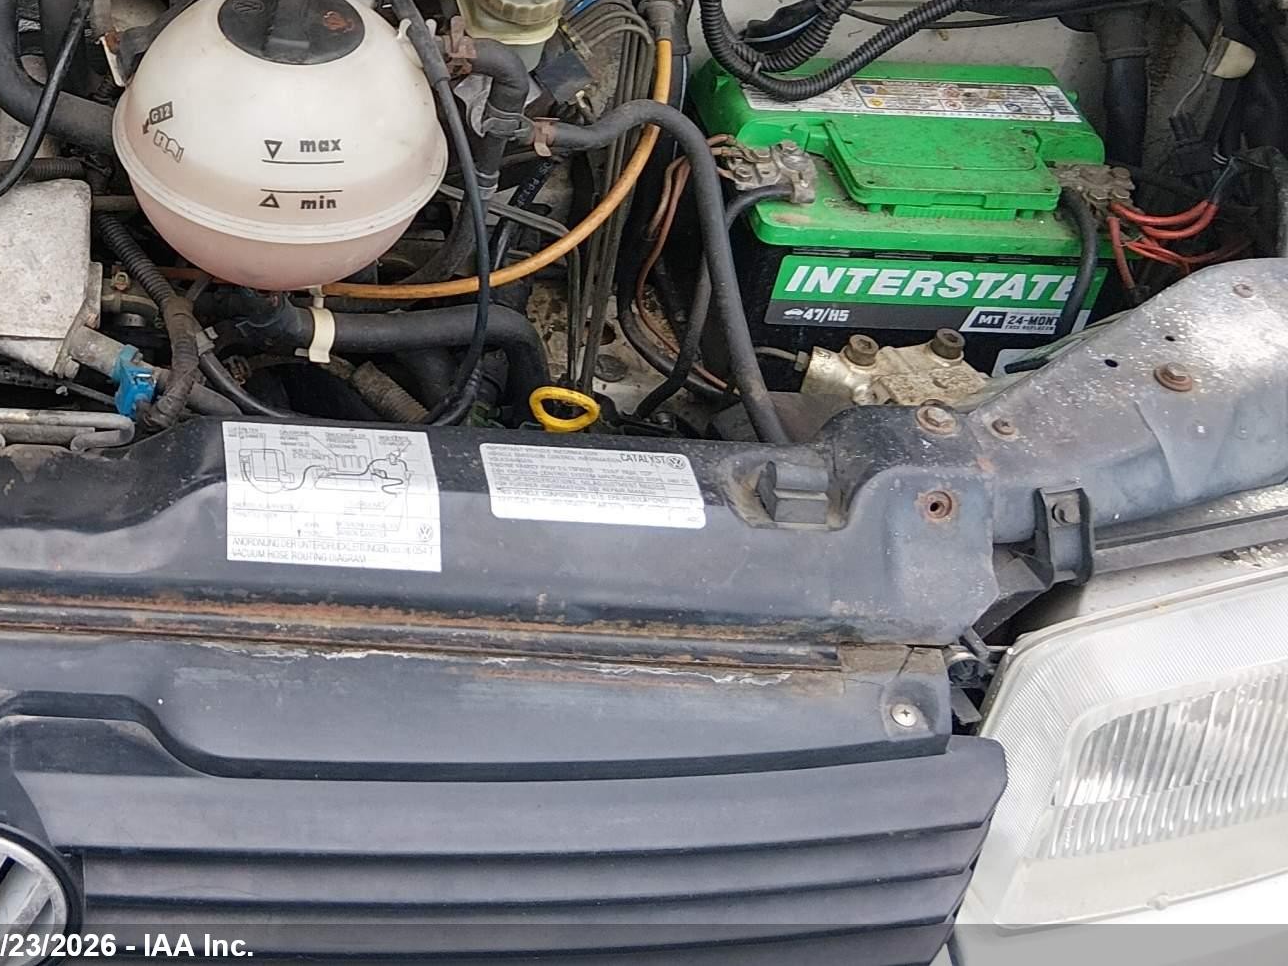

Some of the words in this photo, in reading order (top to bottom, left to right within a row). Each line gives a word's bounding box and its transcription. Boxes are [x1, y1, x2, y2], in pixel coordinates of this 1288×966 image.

[299, 139, 342, 153] max
[300, 195, 337, 209] min
[978, 313, 1002, 325] MT
[620, 453, 665, 466] CATALYST
[232, 547, 265, 557] VACUUM
[267, 550, 289, 559] HOSE
[291, 551, 327, 562] ROUTING
